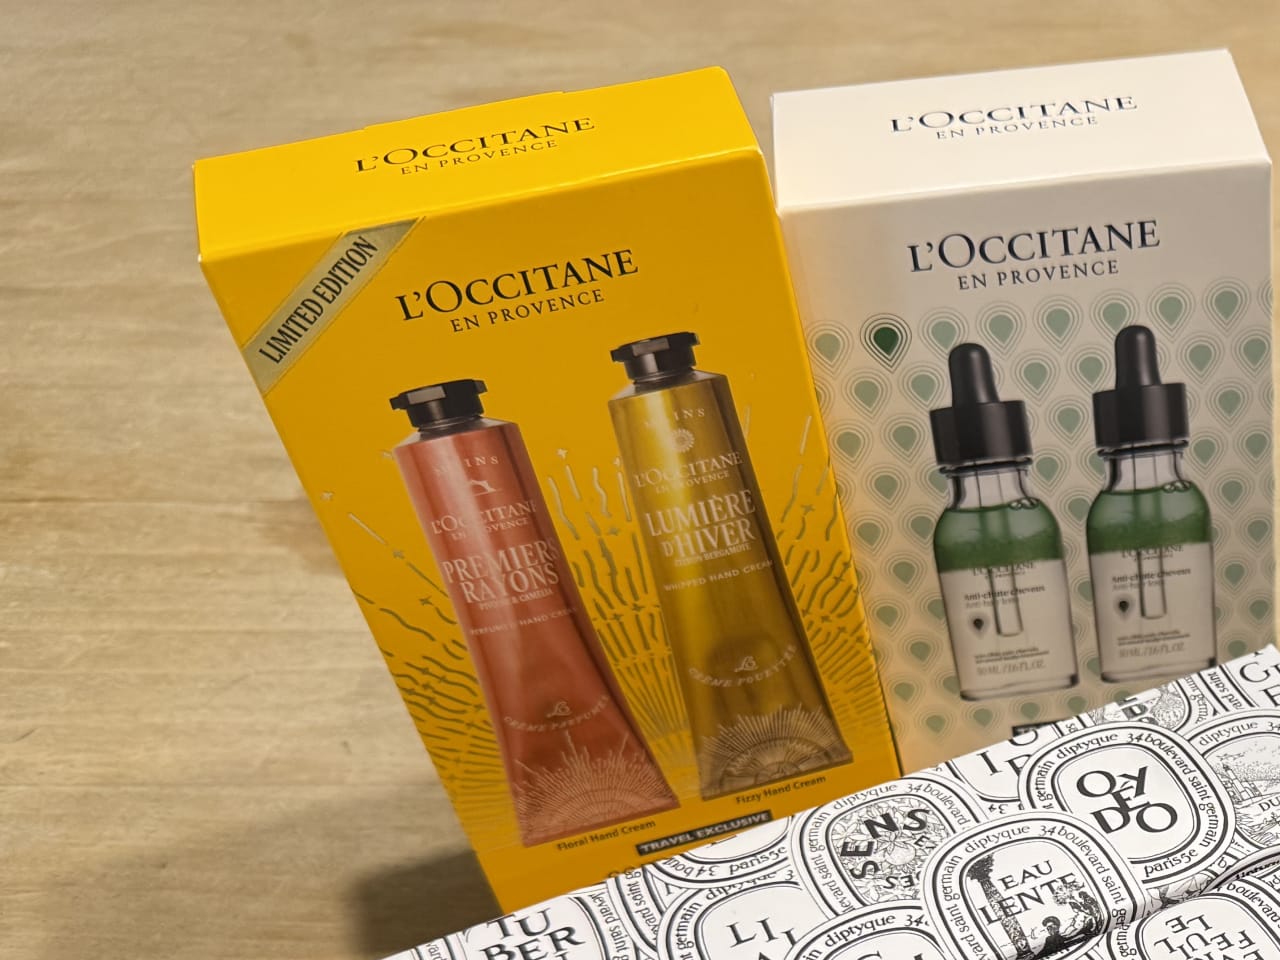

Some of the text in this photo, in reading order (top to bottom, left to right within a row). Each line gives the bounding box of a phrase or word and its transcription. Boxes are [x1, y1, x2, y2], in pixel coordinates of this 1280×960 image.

[936, 115, 1099, 140] EN PROVENCE
[401, 139, 558, 175] EN PROVENCE
[957, 259, 1119, 291] EN PROVENCE
[259, 236, 378, 364] LIMITED EDITION
[450, 289, 605, 333] EN PROVENCE
[646, 489, 756, 536] LUMIÈRE
[459, 562, 559, 604] RAYONS
[709, 568, 739, 582] HAND
[1055, 732, 1119, 759] diptyque
[640, 813, 770, 853] TRAVEL EXCLUSIVE
[964, 824, 1030, 853] diptyque
[998, 859, 1055, 891] EAU
[976, 872, 1087, 927] LENTE
[823, 913, 897, 948] diptyque
